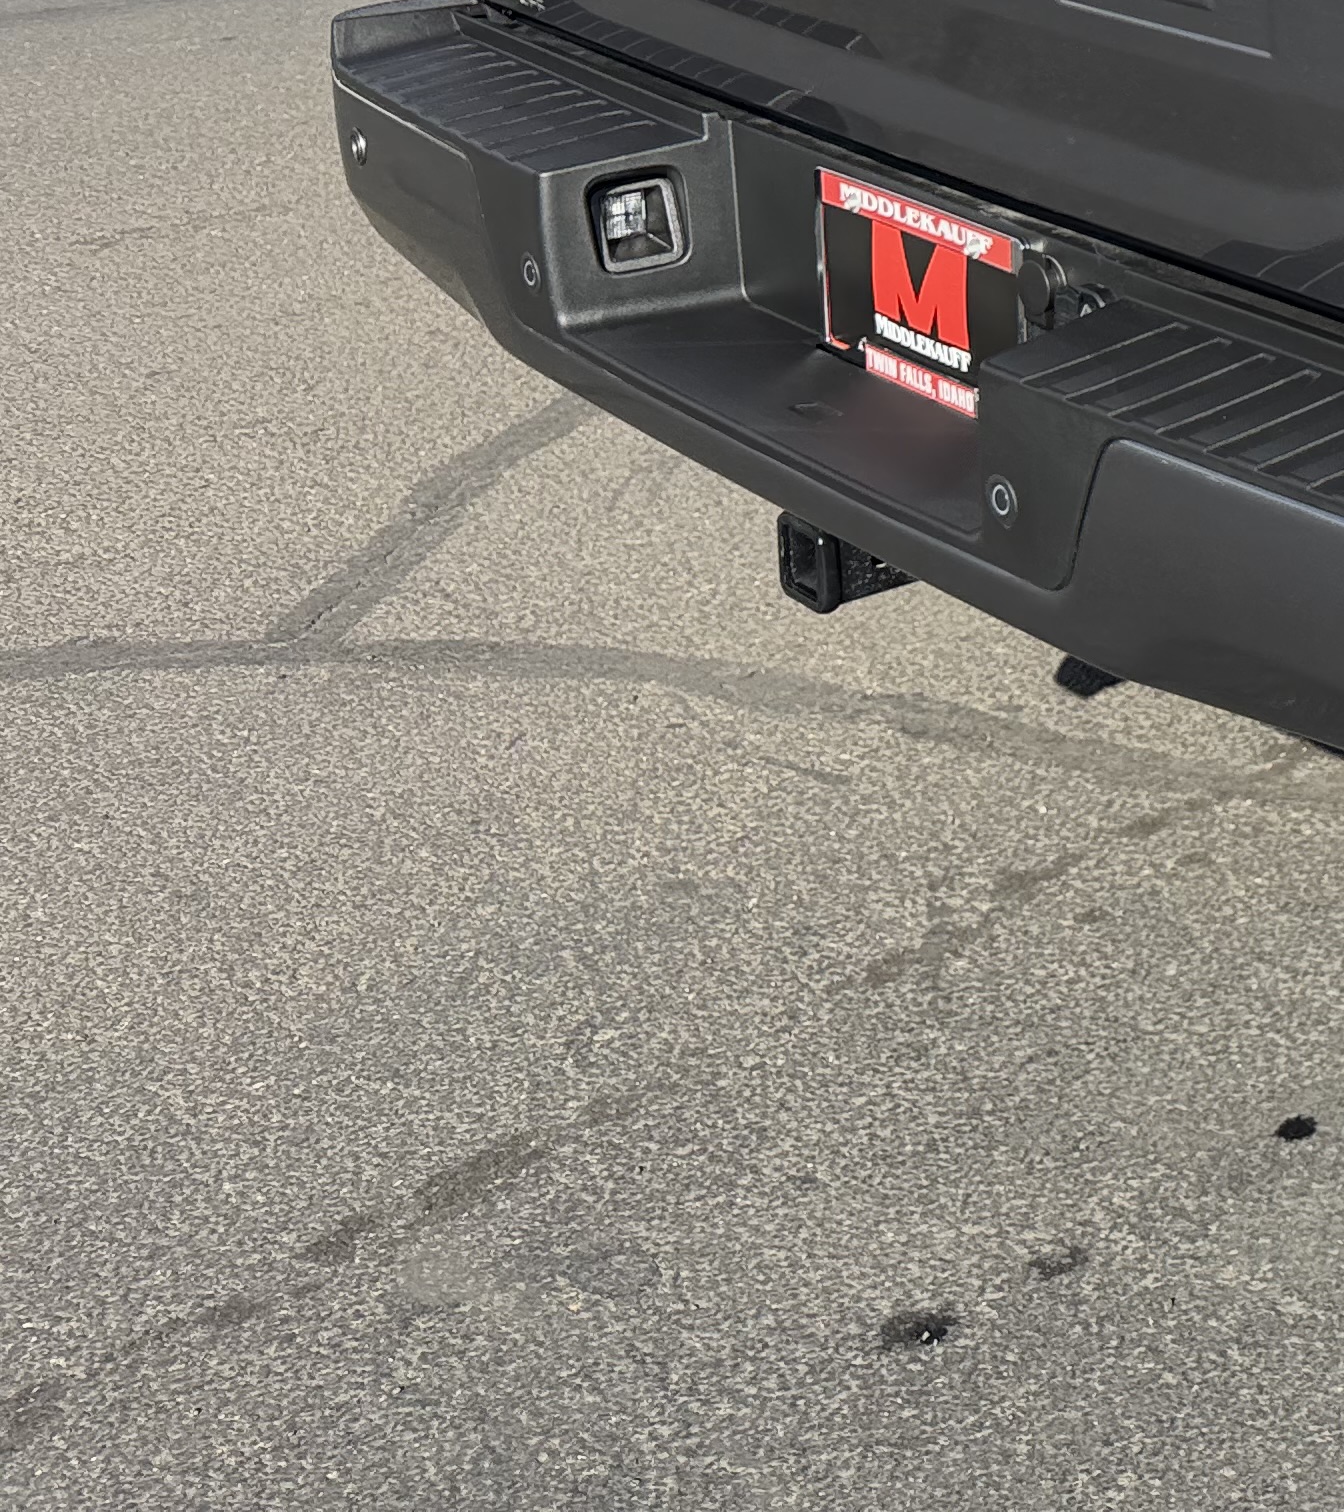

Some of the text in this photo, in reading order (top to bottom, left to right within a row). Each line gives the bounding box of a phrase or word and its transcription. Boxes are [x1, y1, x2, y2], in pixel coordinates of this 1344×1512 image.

[875, 313, 972, 373] MIDDLEKAUFF
[866, 346, 975, 413] TWIN FALLS, IDAHO
